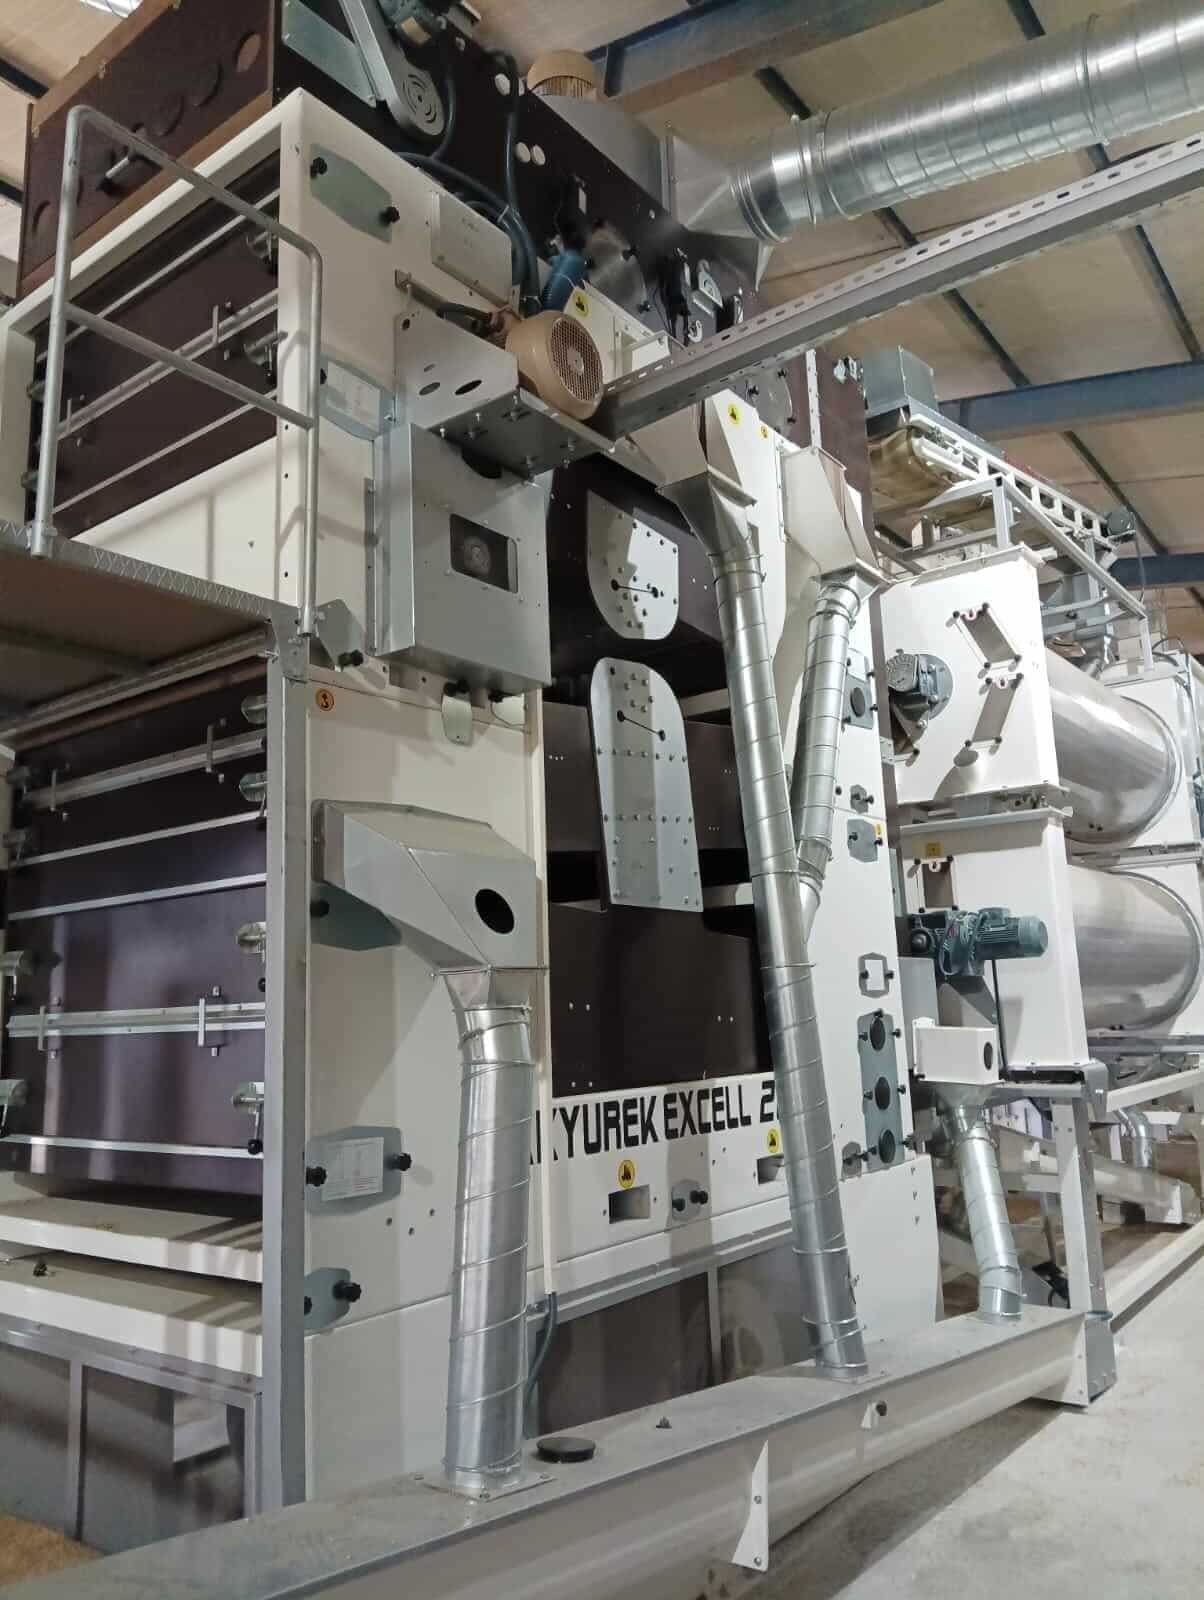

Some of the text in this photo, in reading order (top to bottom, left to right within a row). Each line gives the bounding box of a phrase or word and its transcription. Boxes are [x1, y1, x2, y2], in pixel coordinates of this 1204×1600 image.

[530, 1080, 779, 1165] KYUREK EXCELL 2
